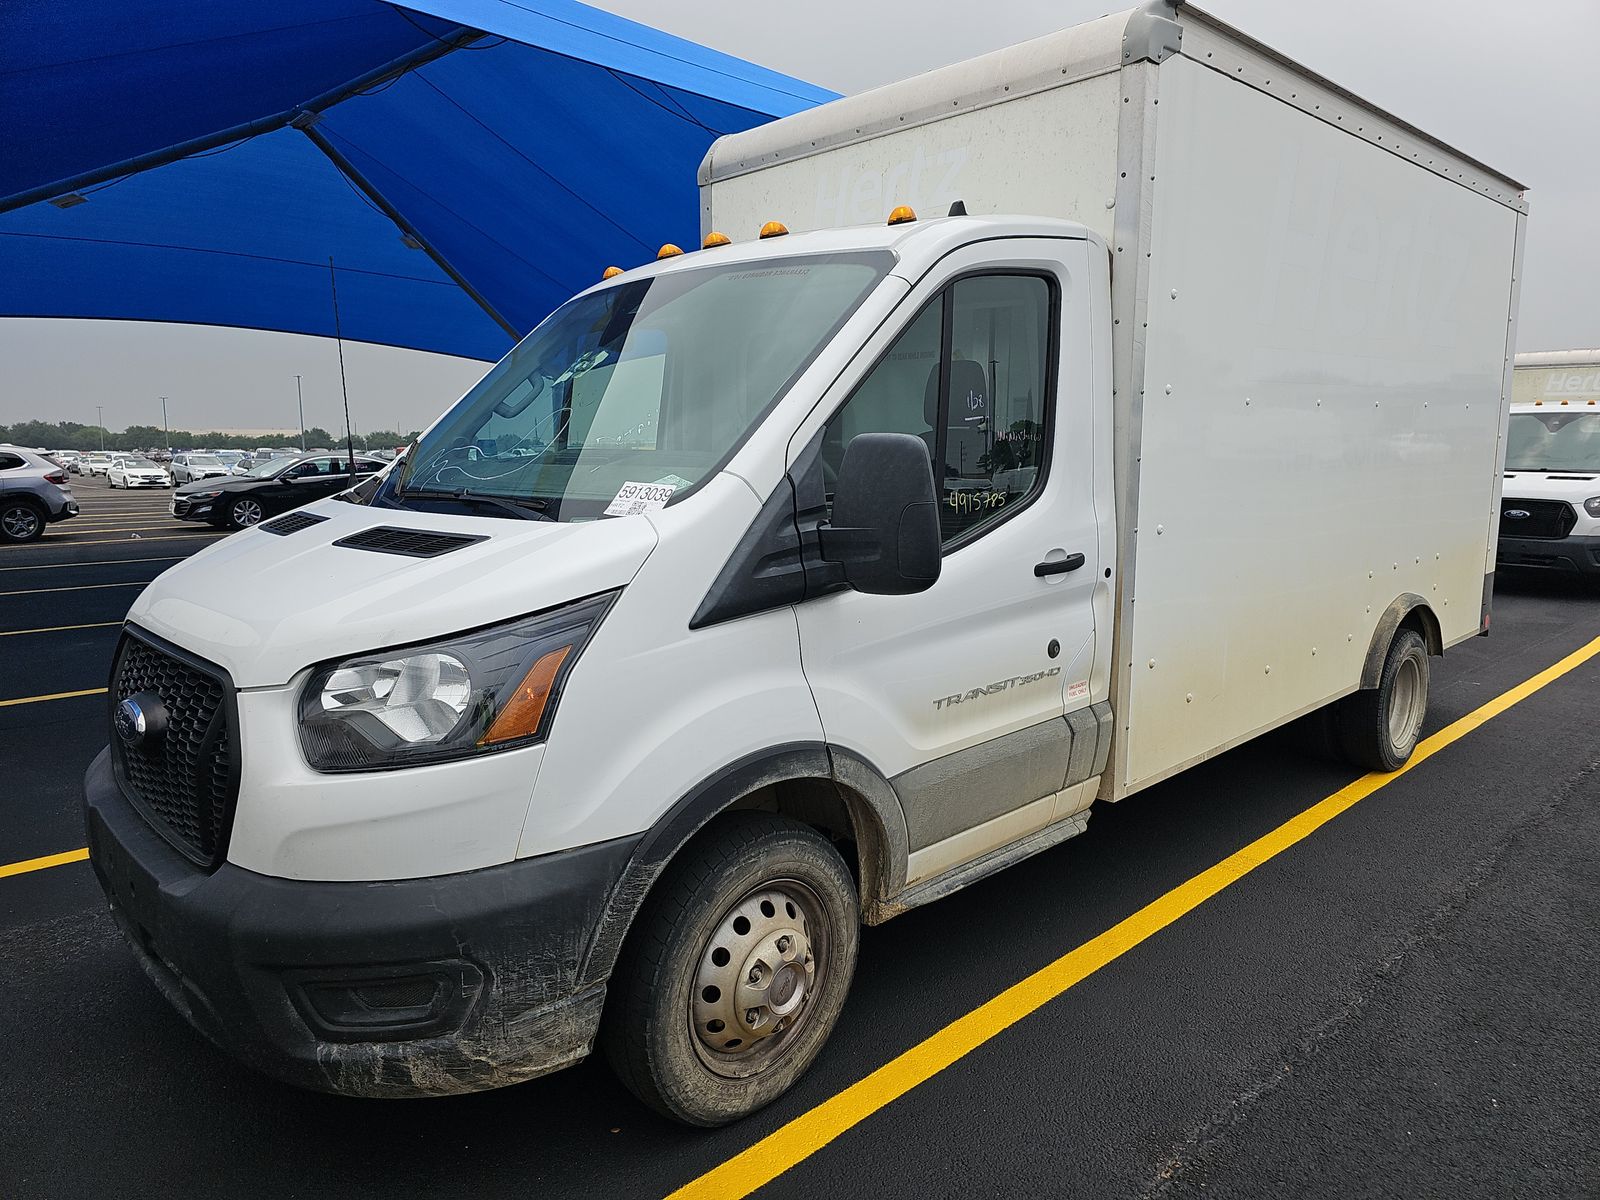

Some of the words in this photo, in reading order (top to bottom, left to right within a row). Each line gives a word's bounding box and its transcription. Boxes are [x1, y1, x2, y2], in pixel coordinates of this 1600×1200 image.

[814, 146, 968, 227] Hertz
[619, 485, 673, 502] 5913039
[949, 491, 1007, 515] 4915785
[932, 675, 1020, 711] TRANSIT
